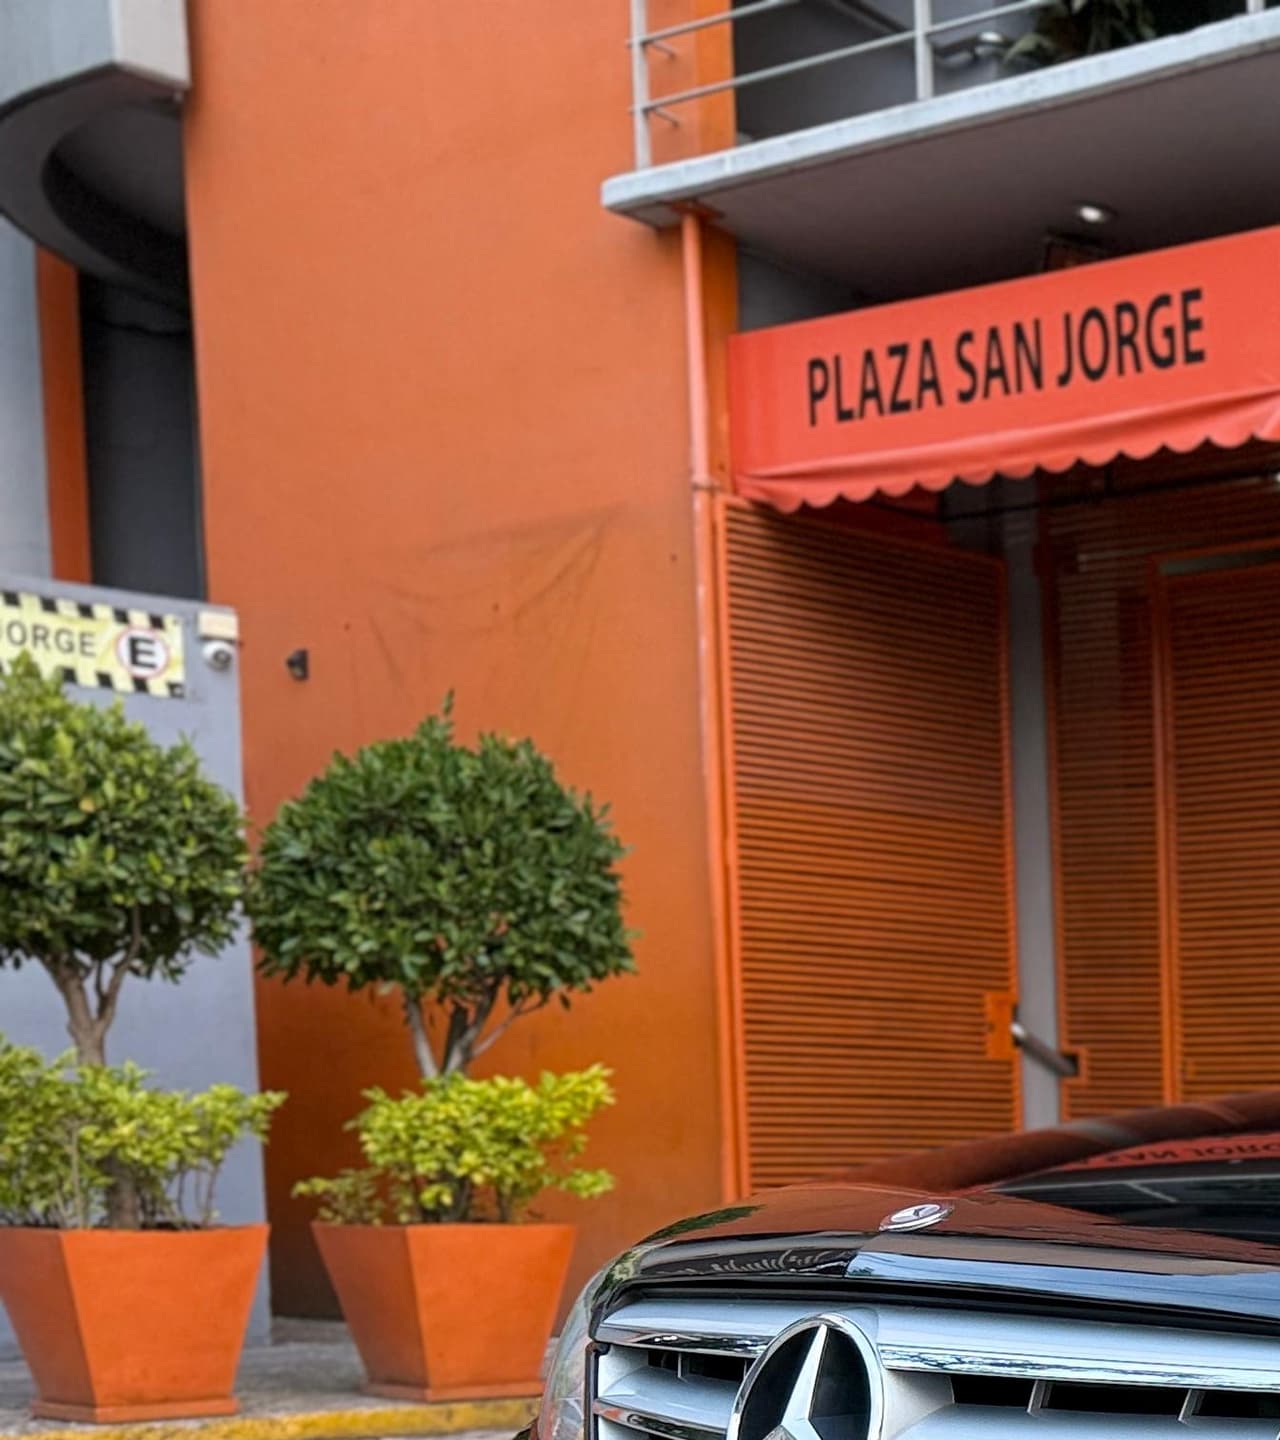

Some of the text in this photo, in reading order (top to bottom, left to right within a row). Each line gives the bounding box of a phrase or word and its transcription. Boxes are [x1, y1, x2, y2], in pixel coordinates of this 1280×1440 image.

[807, 287, 1207, 427] PLAZA SAN JORGE
[0, 619, 97, 658] ORGE
[128, 635, 158, 670] E
